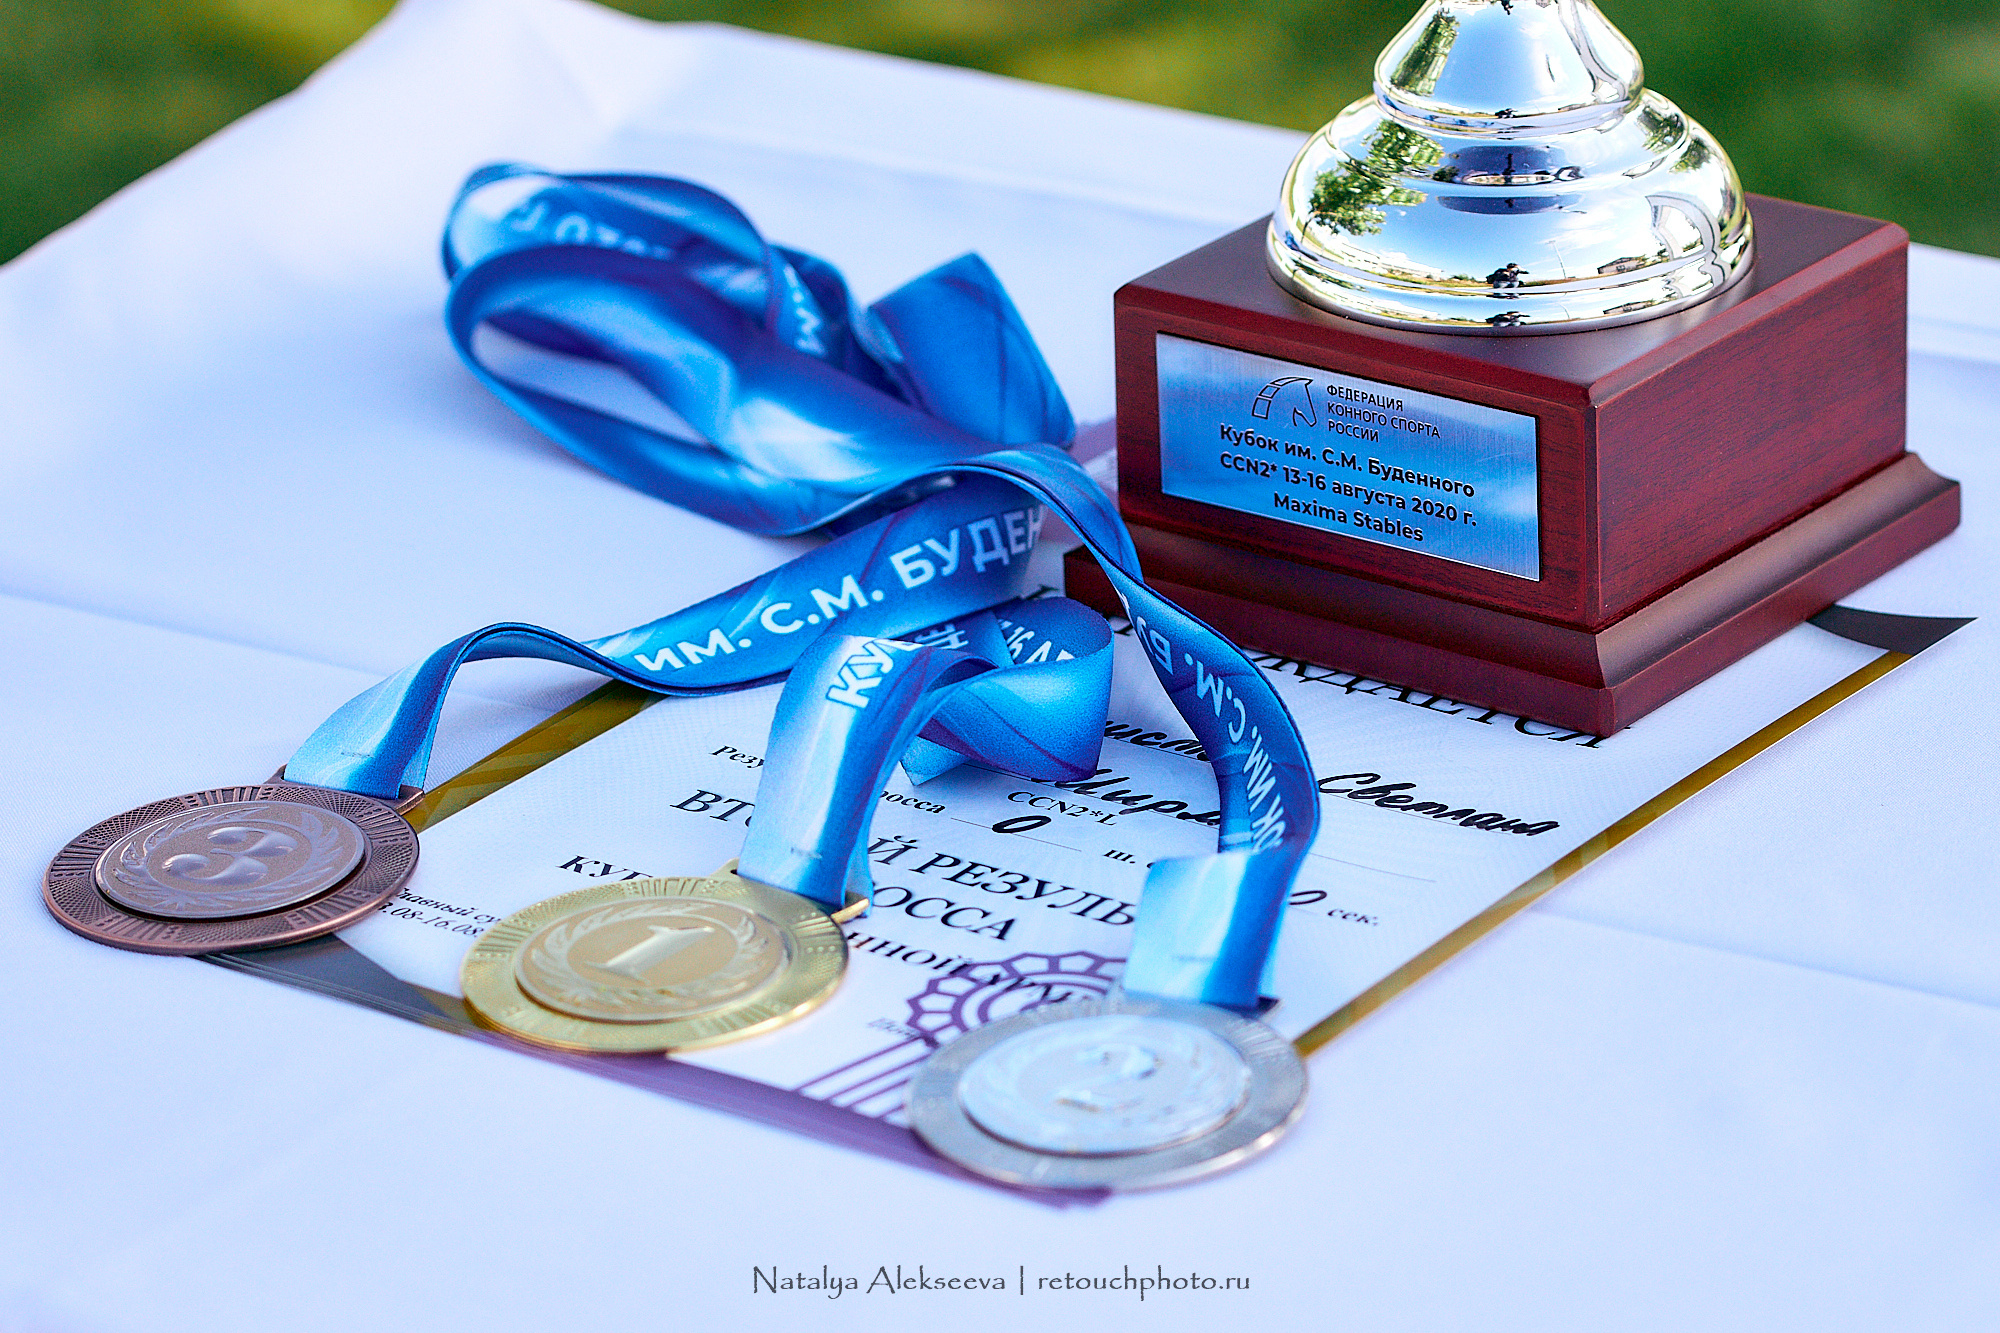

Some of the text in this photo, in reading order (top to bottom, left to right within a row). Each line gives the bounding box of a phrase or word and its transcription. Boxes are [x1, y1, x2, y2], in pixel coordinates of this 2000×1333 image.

[1327, 385, 1404, 411] ФЕДЕРАЦИЯ
[1327, 402, 1441, 439] КОННОГО СПОРТА
[1328, 420, 1379, 442] РОССИИ
[1220, 424, 1475, 498] Кубок им. С.М. Буденного
[1274, 492, 1424, 542] Maxima Stables
[1283, 466, 1327, 491] 13-16
[1332, 480, 1406, 510] августа
[1411, 496, 1458, 522] 2020
[1463, 510, 1477, 527] г.
[634, 503, 1047, 672] ИМ. С.М. БУДЕН
[826, 639, 896, 709] КУ
[880, 788, 946, 815] росса
[398, 887, 478, 916] лавный
[872, 884, 1018, 940] ОССА
[908, 852, 1136, 926] РЕЗУЛЬ
[586, 922, 715, 987] 1
[847, 931, 972, 977] ННОЙ
